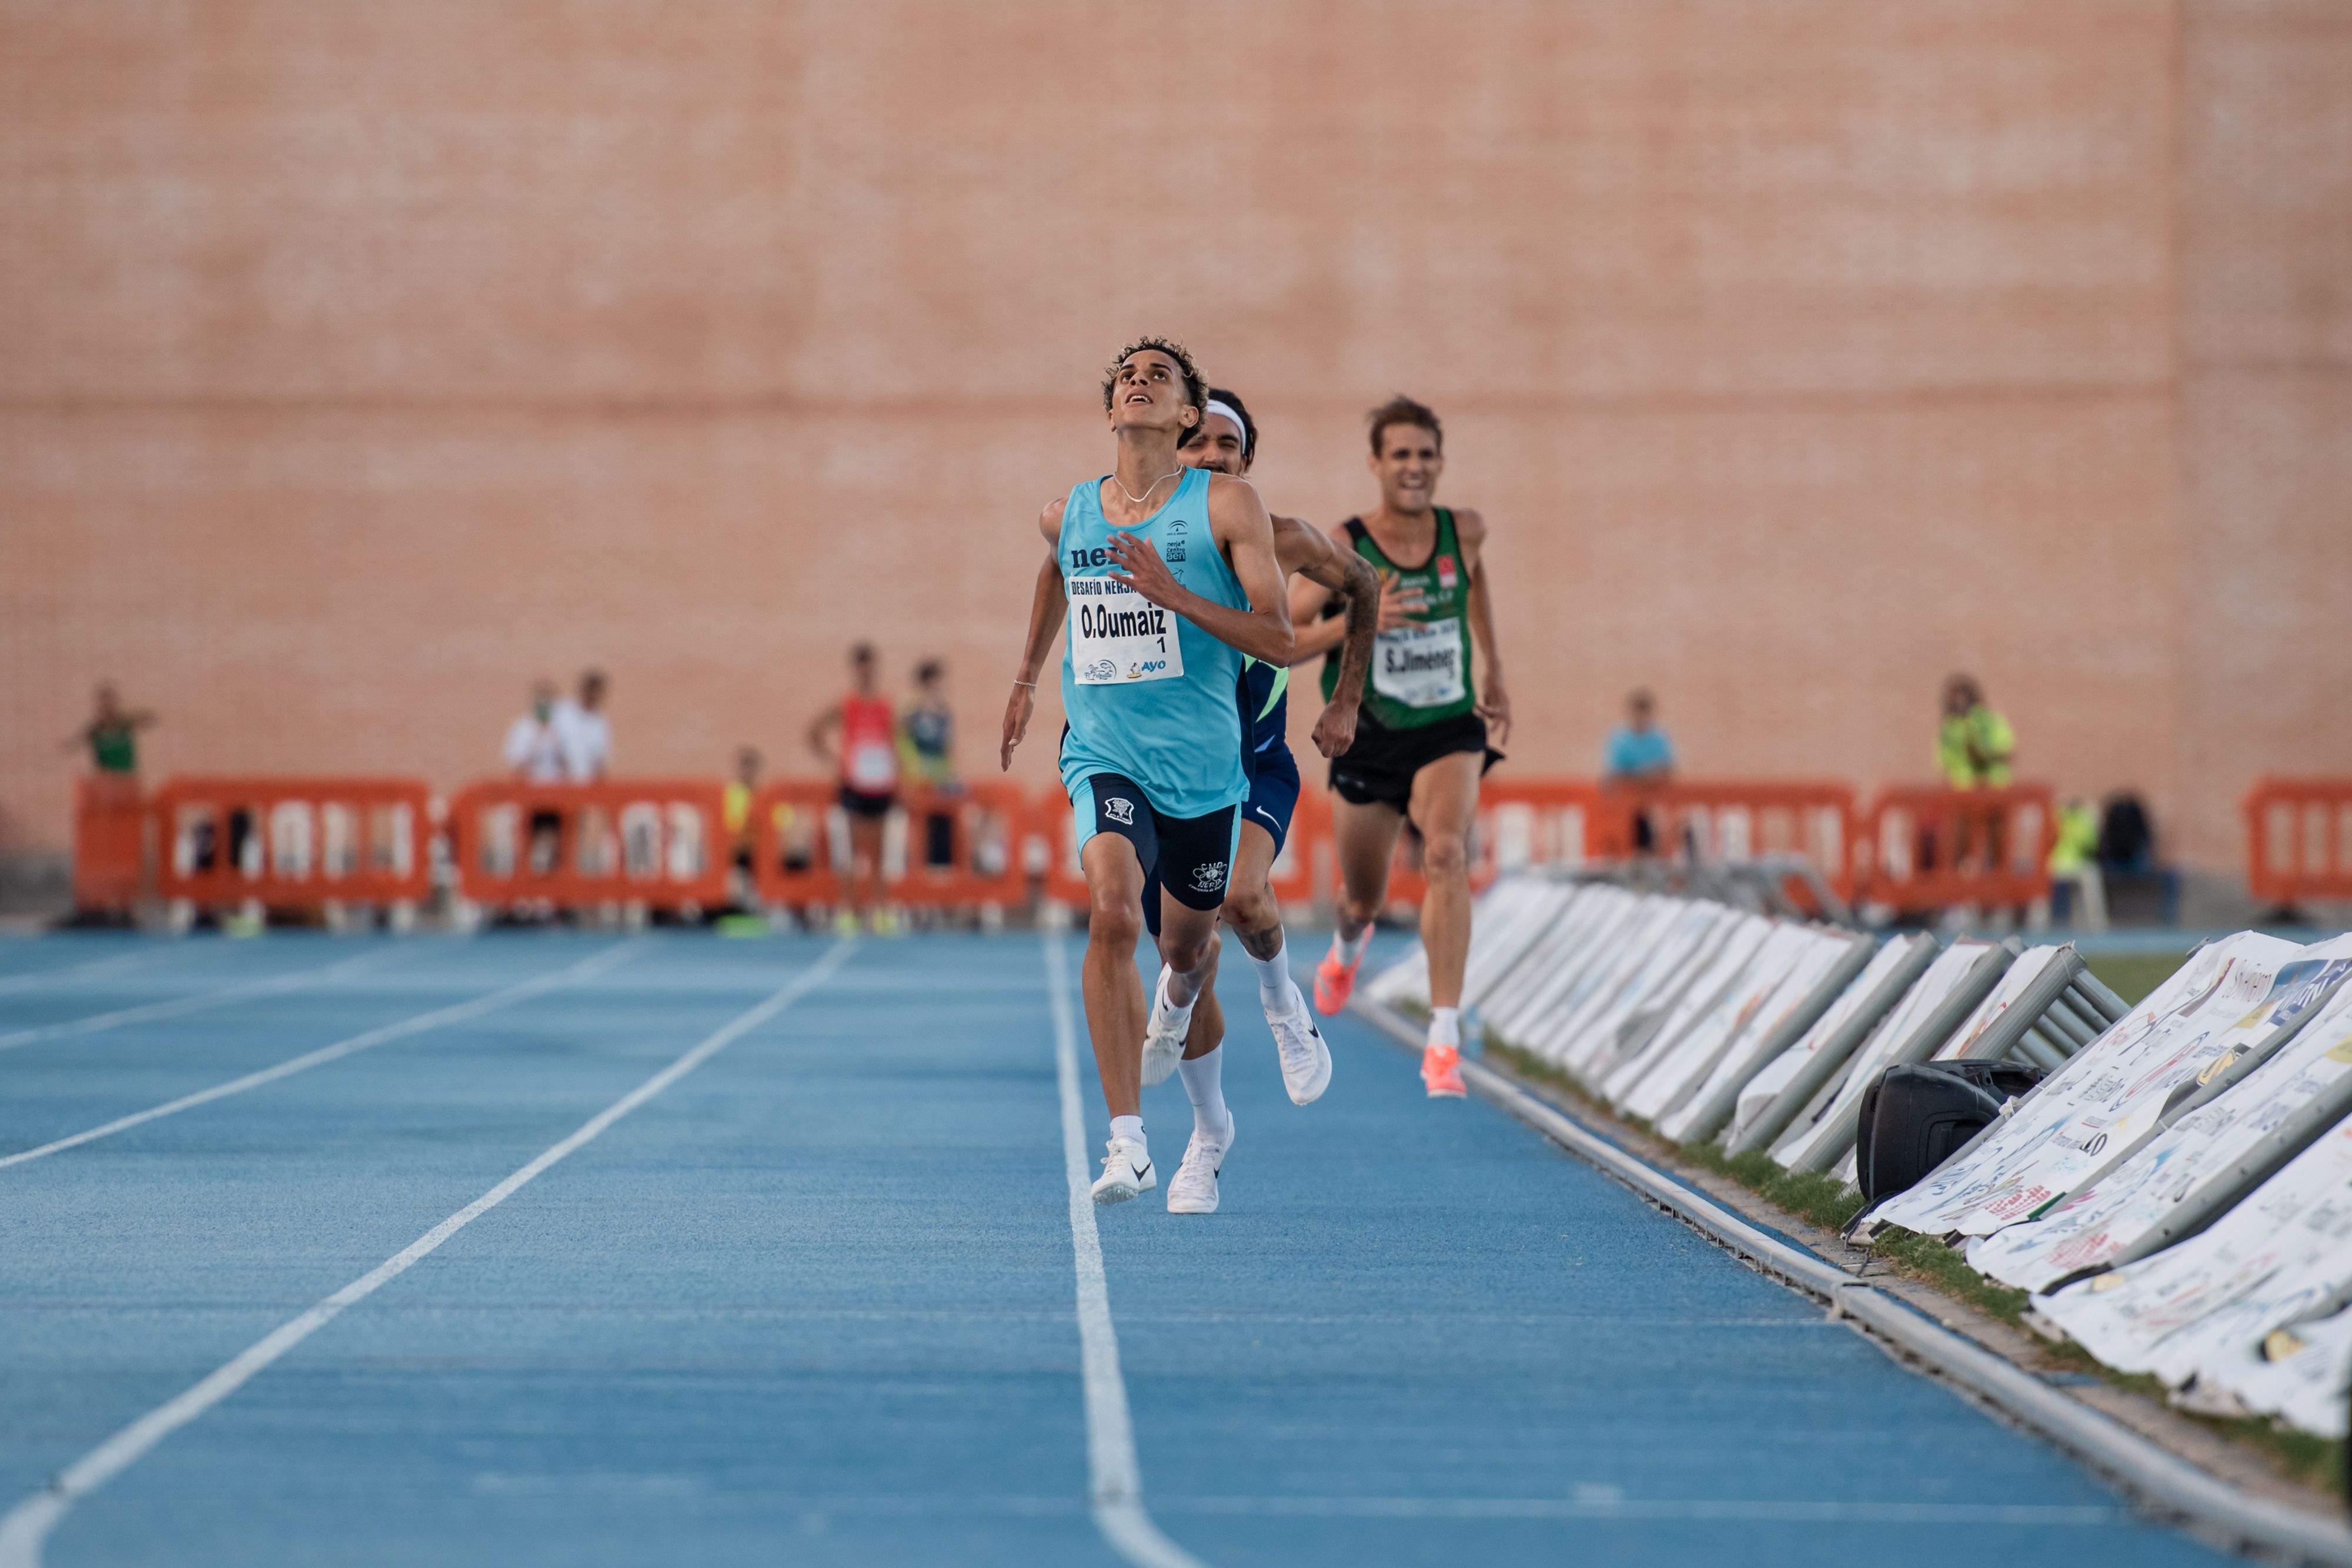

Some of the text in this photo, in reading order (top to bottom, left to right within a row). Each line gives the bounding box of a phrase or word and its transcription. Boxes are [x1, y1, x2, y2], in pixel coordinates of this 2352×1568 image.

[1071, 546, 1129, 570] ner
[1071, 579, 1102, 595] DESAFÍO
[1081, 602, 1167, 638] O.Oumaiz
[1157, 636, 1165, 653] 1
